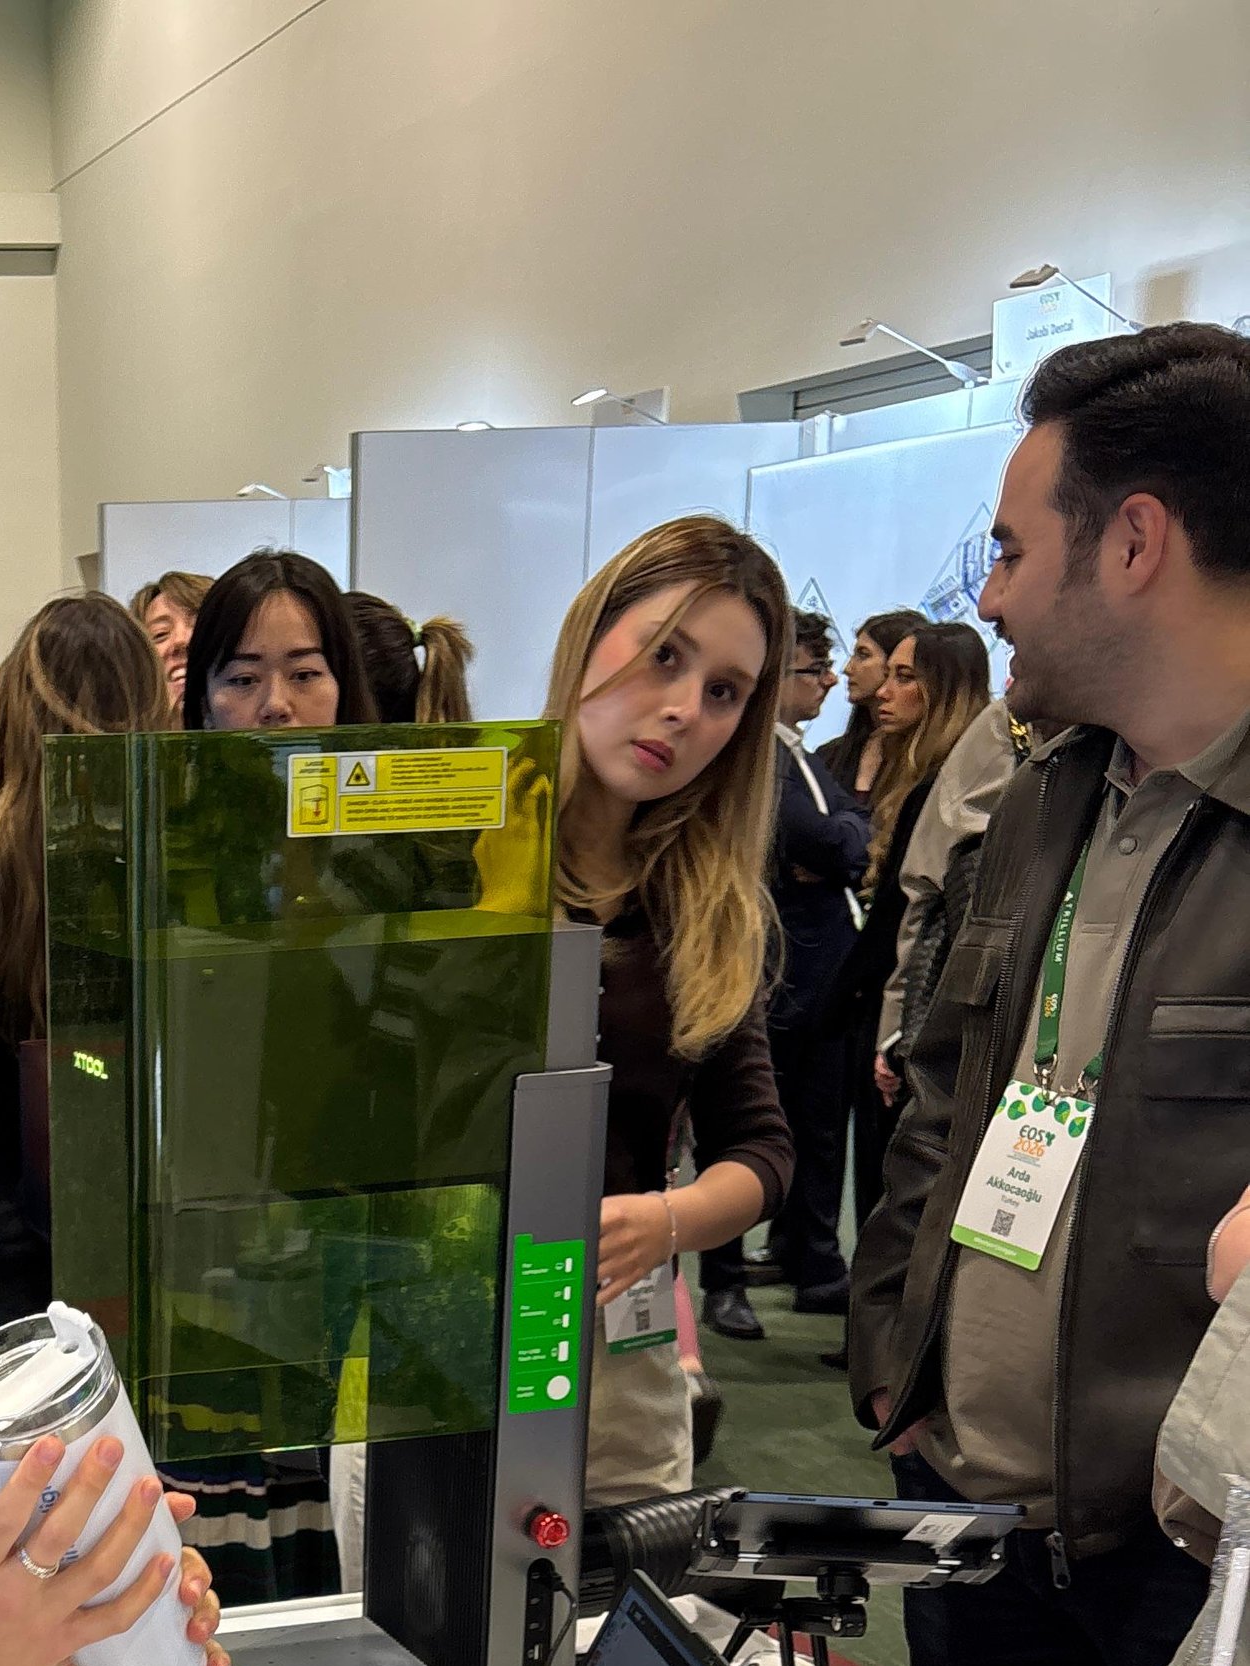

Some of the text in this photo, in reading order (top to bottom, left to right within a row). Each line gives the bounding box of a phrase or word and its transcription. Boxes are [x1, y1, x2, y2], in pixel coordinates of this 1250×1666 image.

[1055, 903, 1073, 963] TRILLIUM
[1019, 1124, 1046, 1142] EOS
[1013, 1137, 1045, 1158] 2026
[1007, 1166, 1031, 1183] Arda
